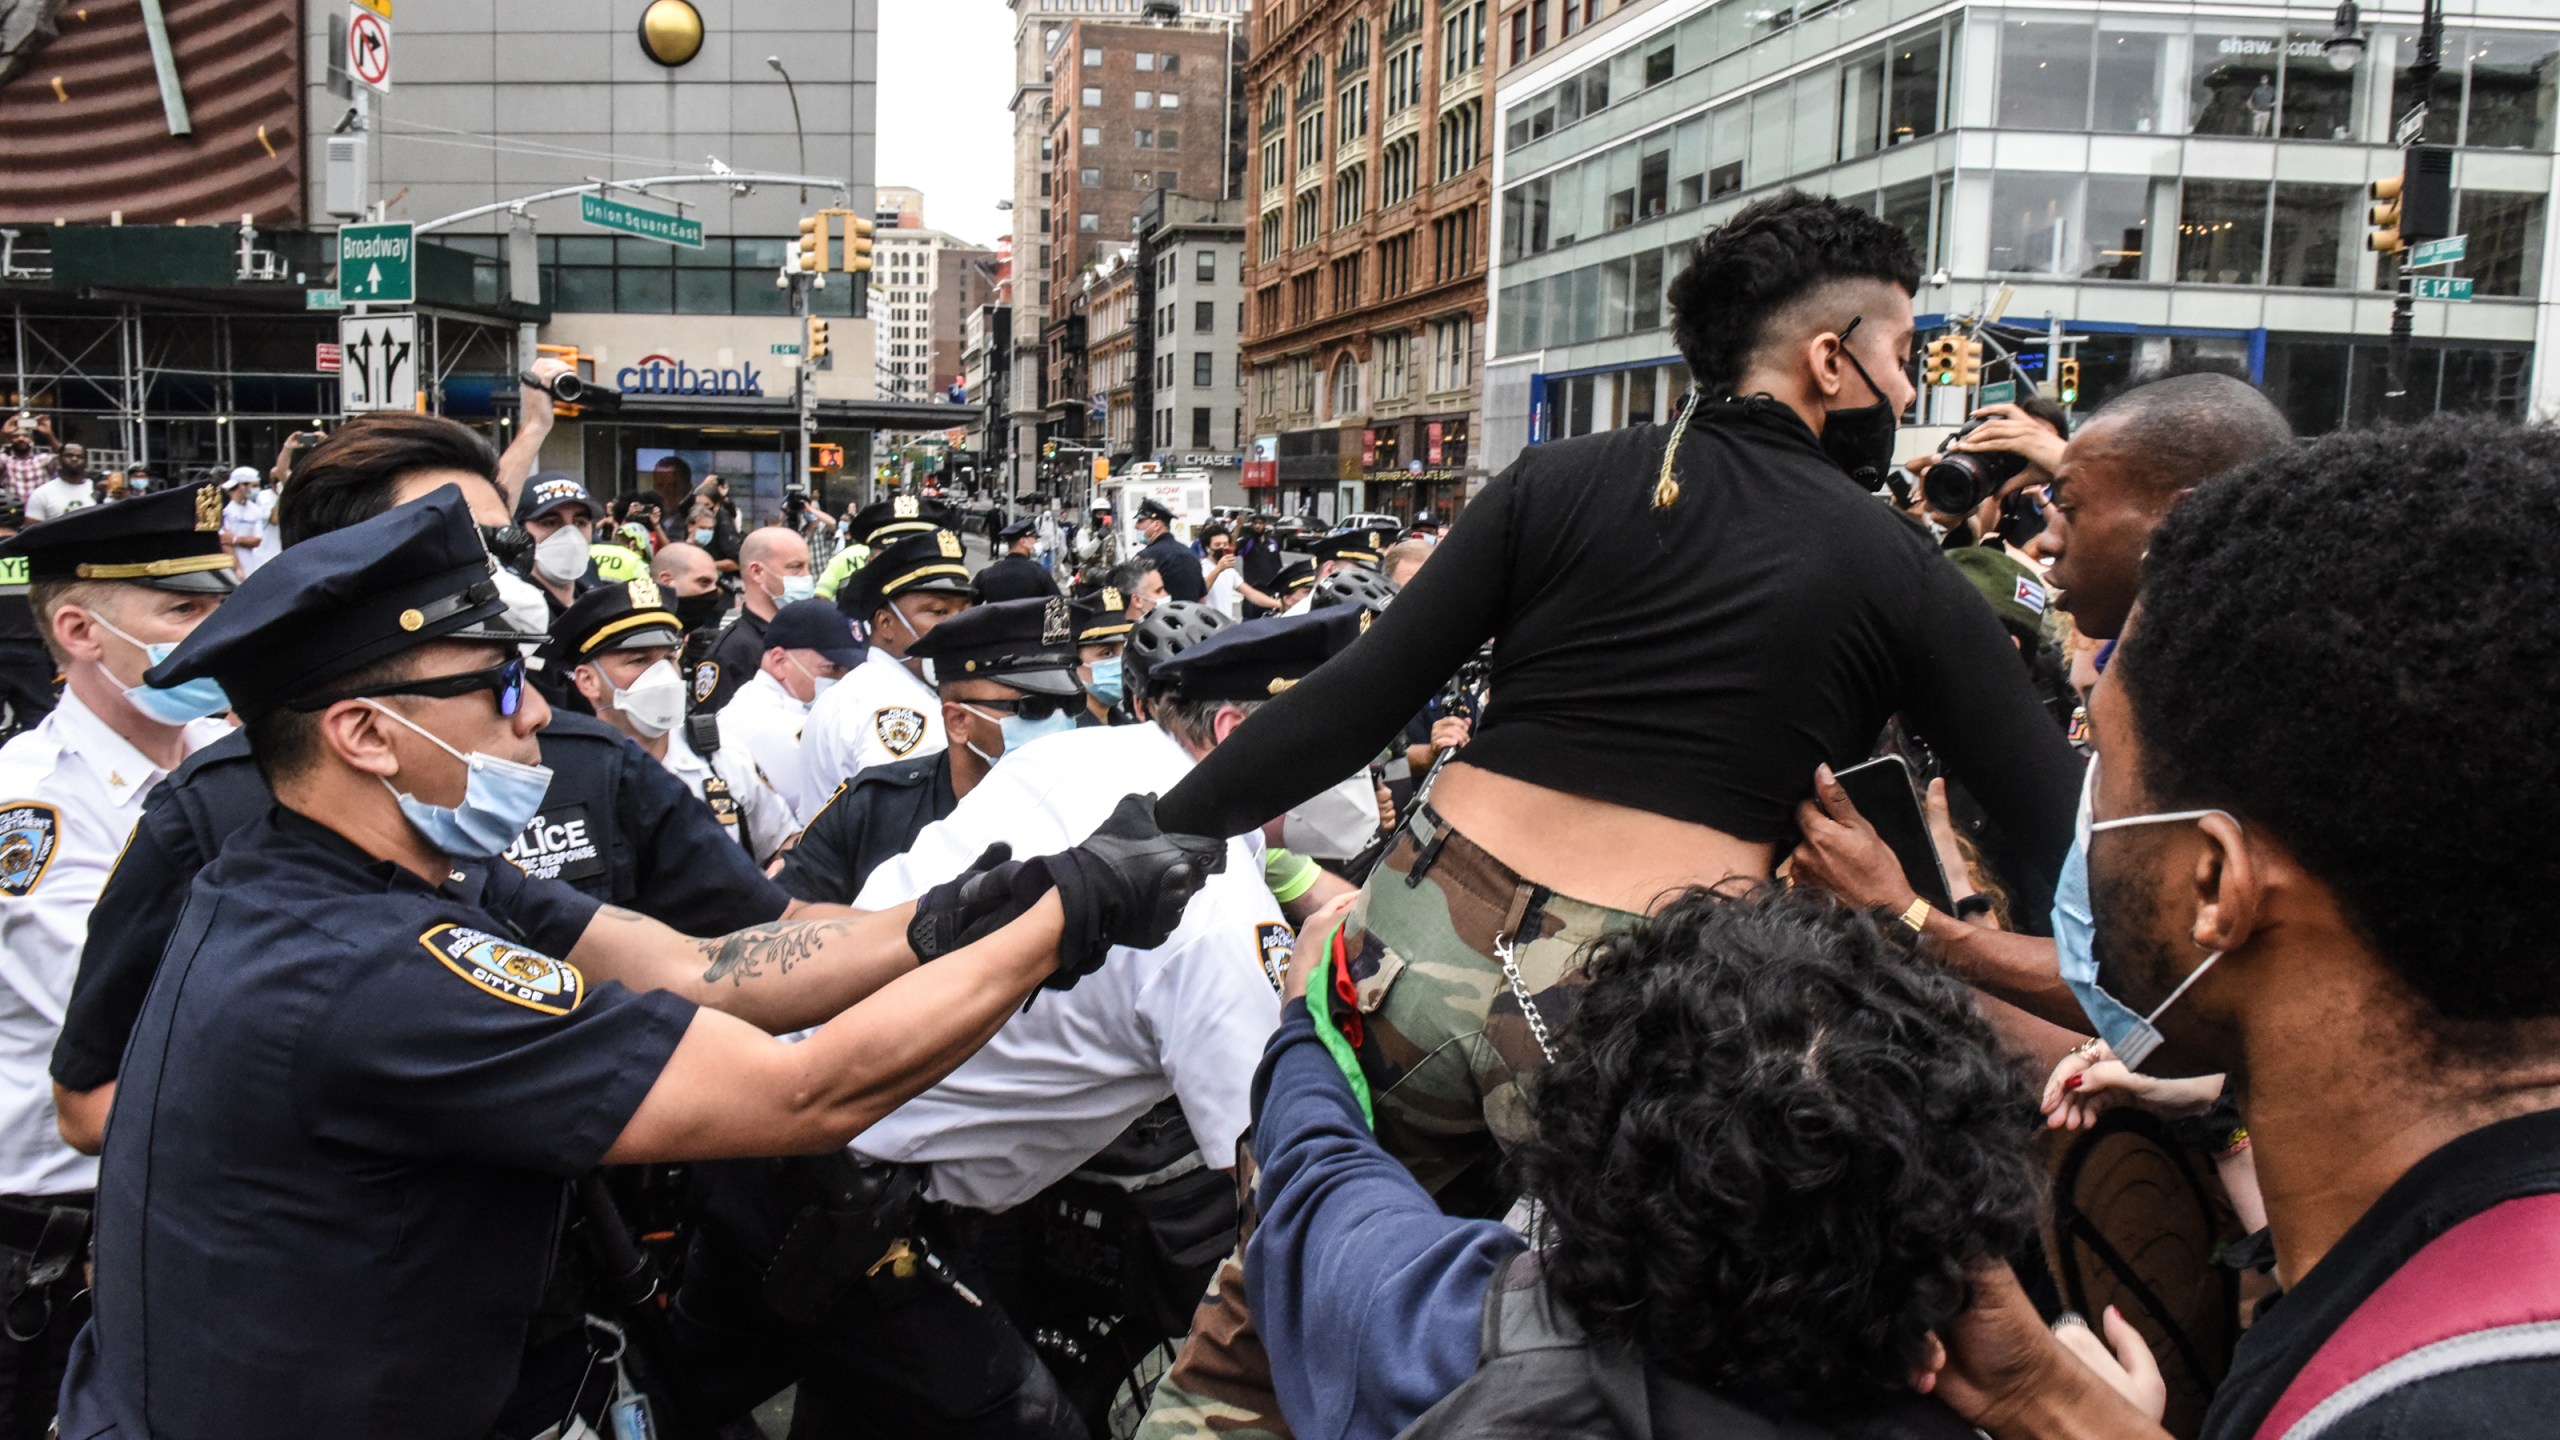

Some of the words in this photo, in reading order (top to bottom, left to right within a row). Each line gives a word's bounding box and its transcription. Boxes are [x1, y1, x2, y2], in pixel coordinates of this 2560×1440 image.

[2218, 36, 2273, 54] shaw
[585, 202, 623, 223] Union
[625, 212, 668, 231] Square
[670, 222, 698, 240] East
[343, 233, 409, 263] Broadway
[2418, 280, 2429, 296] E
[2433, 280, 2450, 298] 14
[2453, 282, 2467, 292] ST
[616, 358, 763, 397] citibank
[1185, 454, 1233, 467] CHASE
[539, 845, 598, 868] RESPONSE
[472, 967, 515, 993] CITY
[517, 988, 545, 1003] OF
